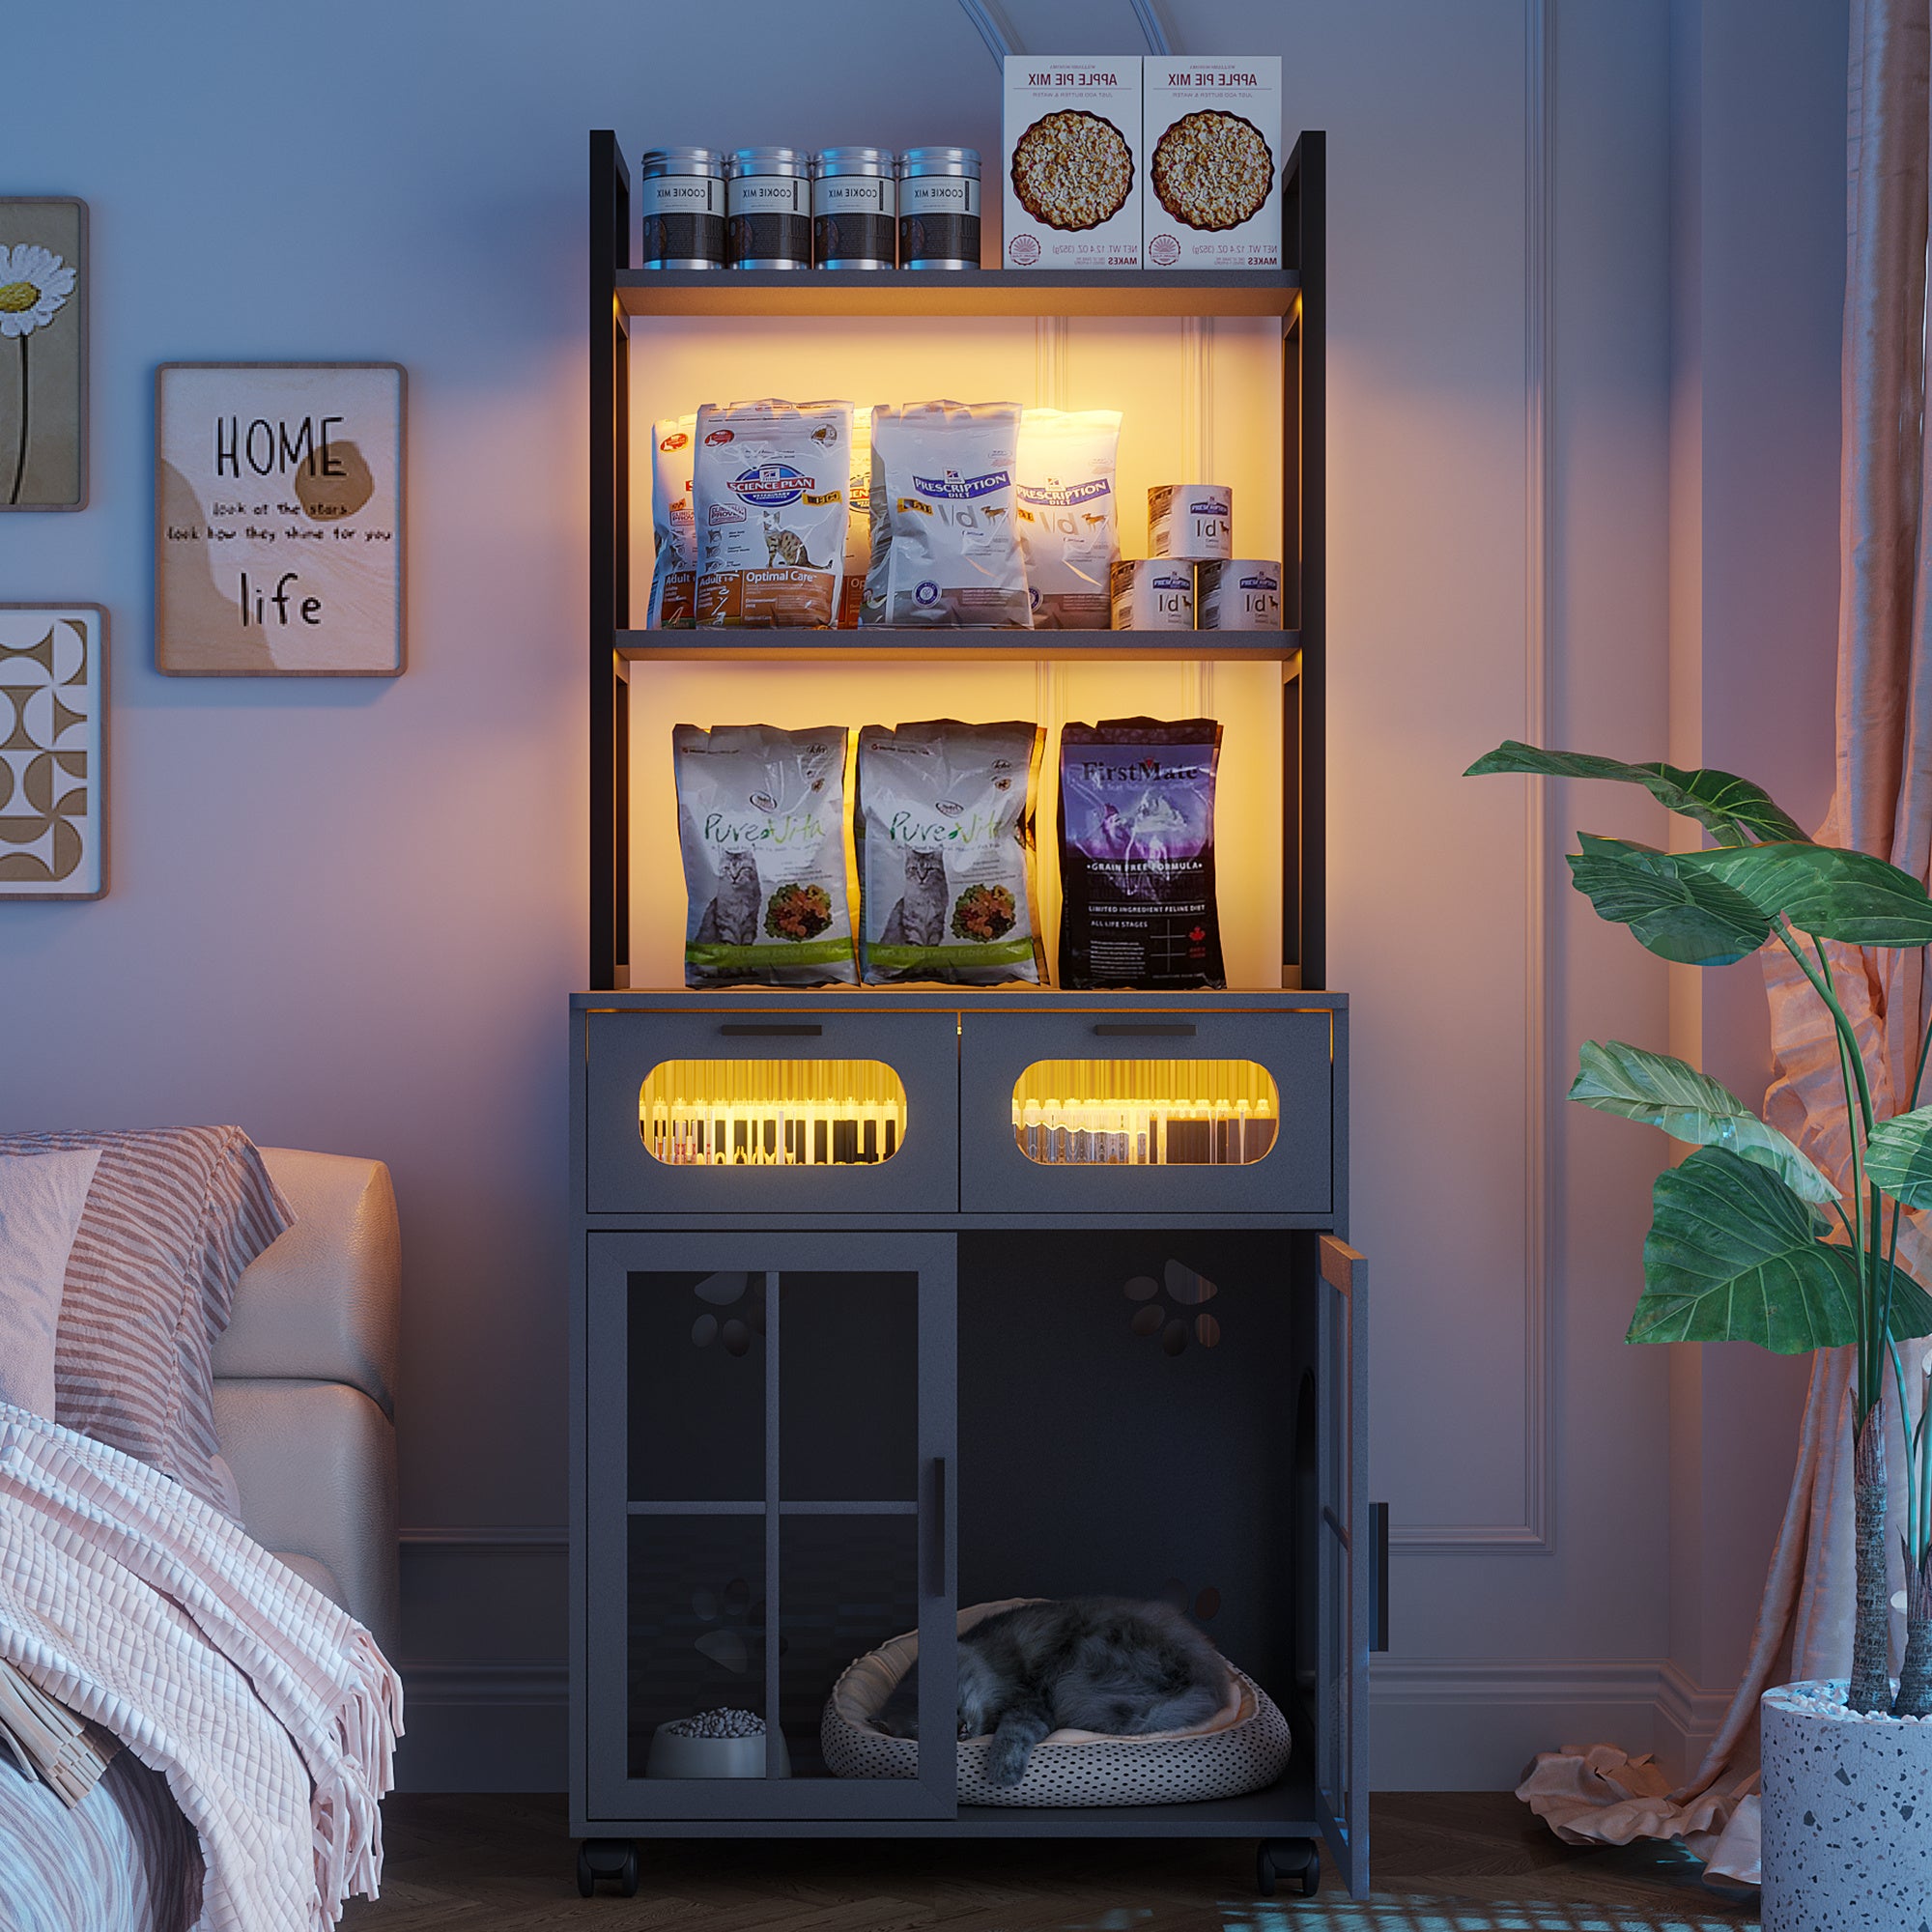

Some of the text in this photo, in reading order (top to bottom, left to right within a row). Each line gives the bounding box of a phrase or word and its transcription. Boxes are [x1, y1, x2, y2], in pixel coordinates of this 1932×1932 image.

[217, 416, 347, 478] HOME
[729, 478, 813, 492] SCIENCE PLAN
[915, 474, 1007, 493] PRESCRIPTION
[1017, 482, 1107, 500] PRESCRIPTION
[213, 502, 349, 516] look at the stars
[208, 526, 237, 541] how
[245, 526, 275, 542] they
[285, 526, 324, 539] shine
[333, 526, 355, 540] for
[364, 529, 391, 541] you
[666, 574, 690, 585] Adult
[699, 576, 723, 588] Adult
[746, 570, 813, 583] Optimal Care
[241, 572, 322, 627] life
[1081, 760, 1199, 781] FirstMate
[704, 812, 759, 842] Pure
[889, 810, 947, 841] Pure
[1091, 862, 1199, 871] GRAIN FREE FORMULA
[1164, 904, 1189, 913] FELINE
[1190, 903, 1206, 912] DIET
